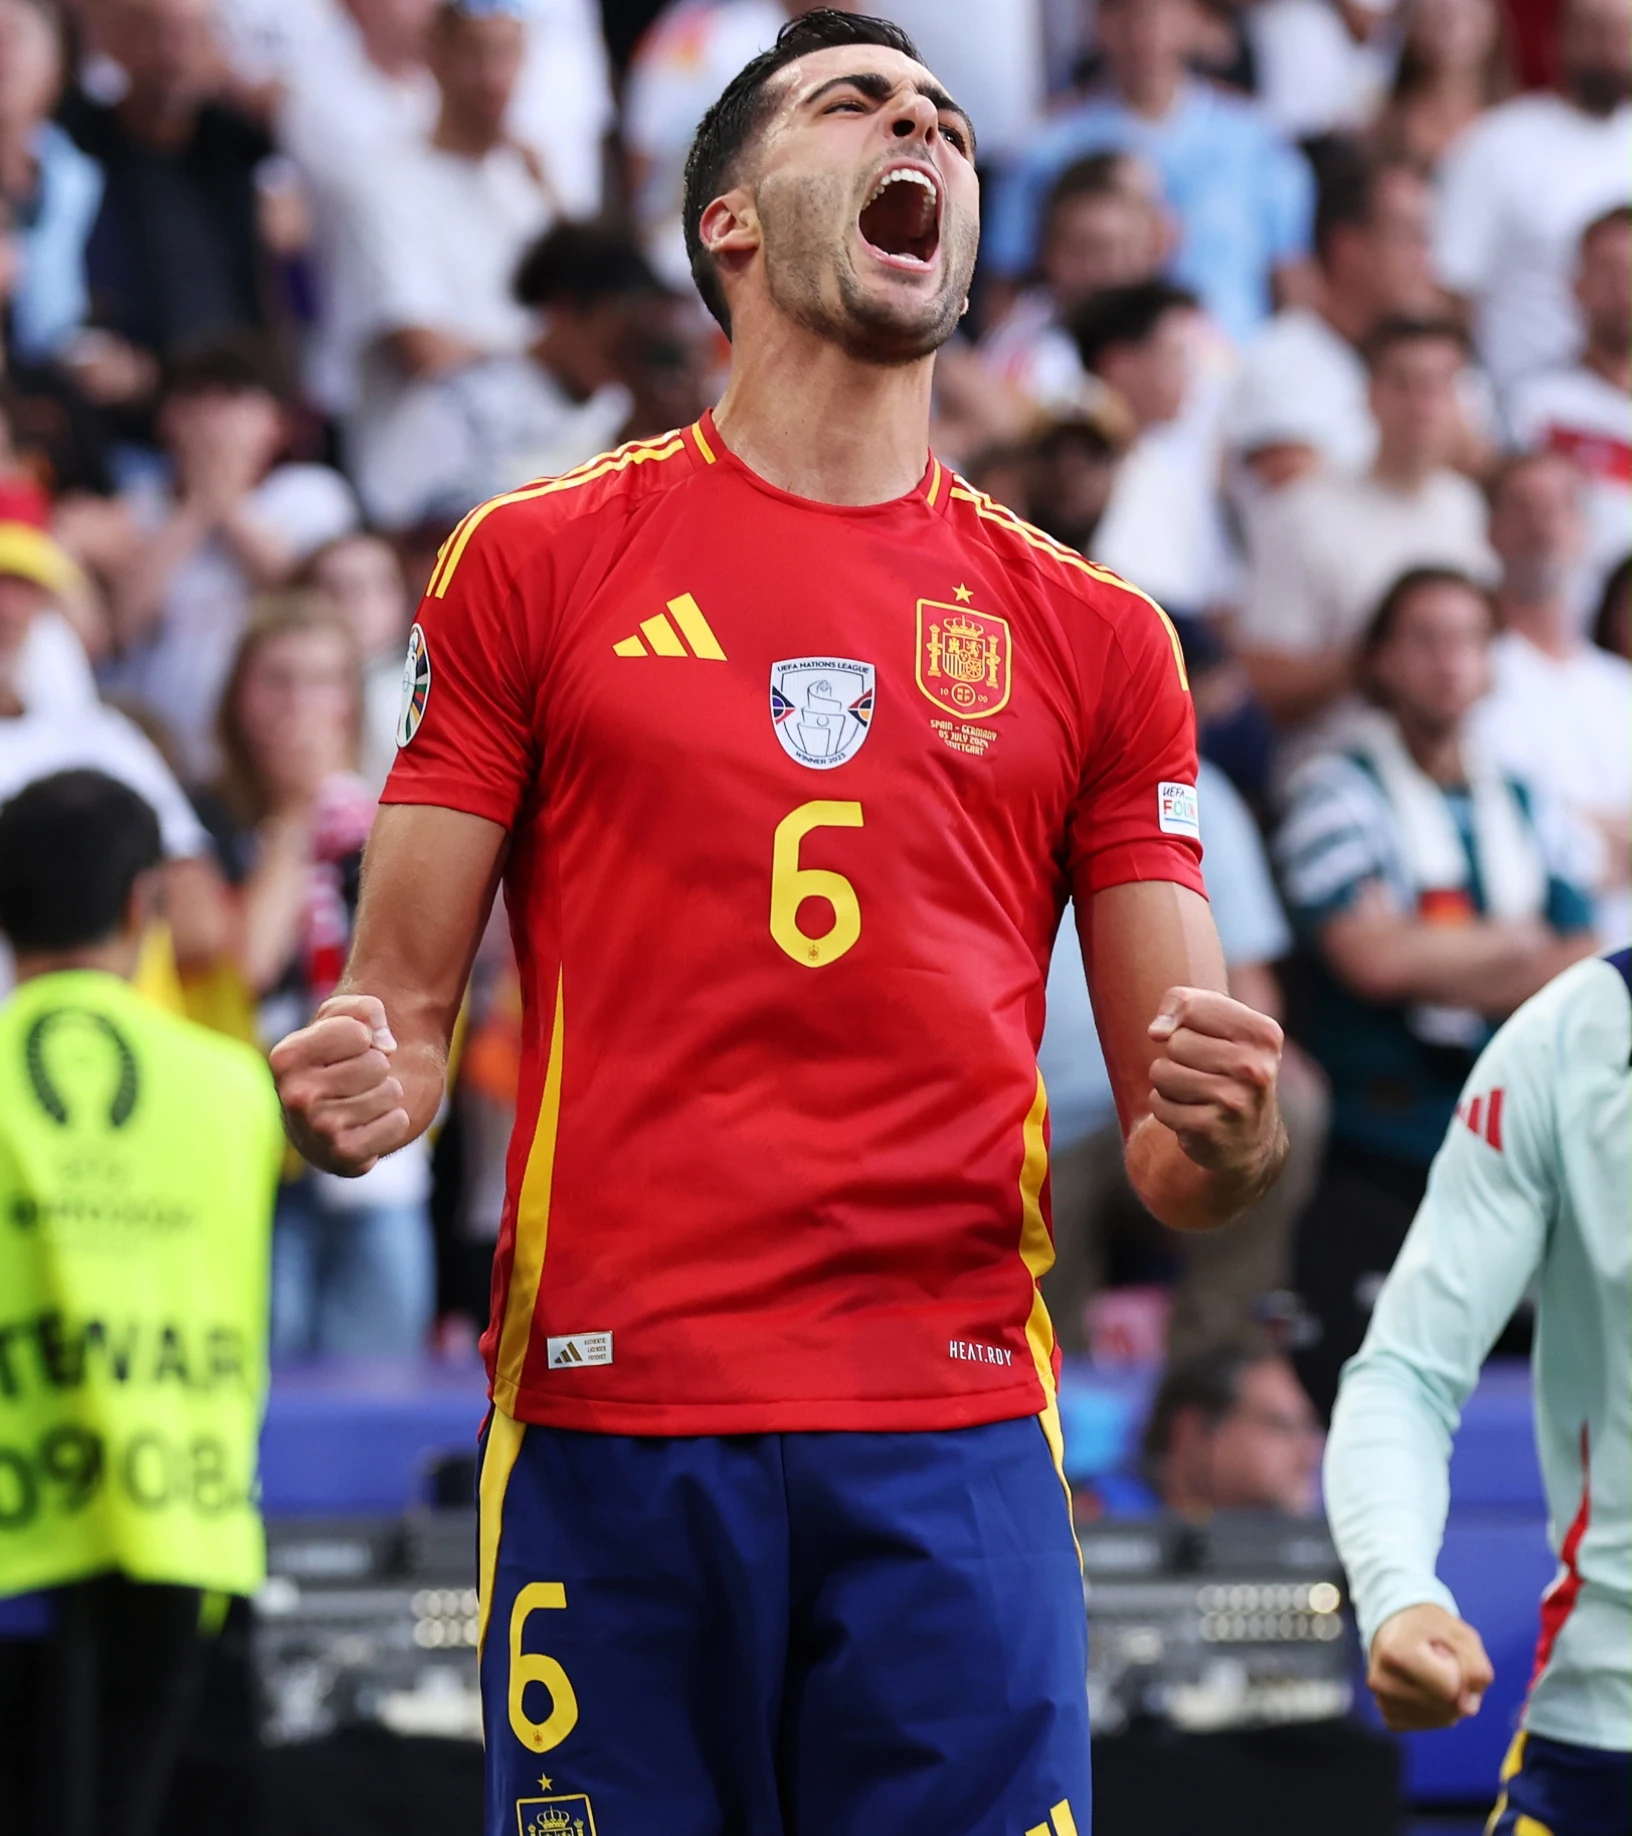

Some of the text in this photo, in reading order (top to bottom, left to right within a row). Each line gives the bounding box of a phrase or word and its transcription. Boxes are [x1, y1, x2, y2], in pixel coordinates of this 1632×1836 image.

[777, 663, 798, 672] UEFA
[838, 662, 870, 674] LEAGUE
[930, 719, 953, 731] SPAIN
[961, 724, 997, 742] GERMANY
[950, 731, 968, 743] JULY
[969, 736, 989, 749] 2024
[796, 751, 826, 764] WINNER
[1163, 786, 1184, 798] UEFA
[769, 800, 864, 968] 6
[508, 1582, 579, 1754] 6
